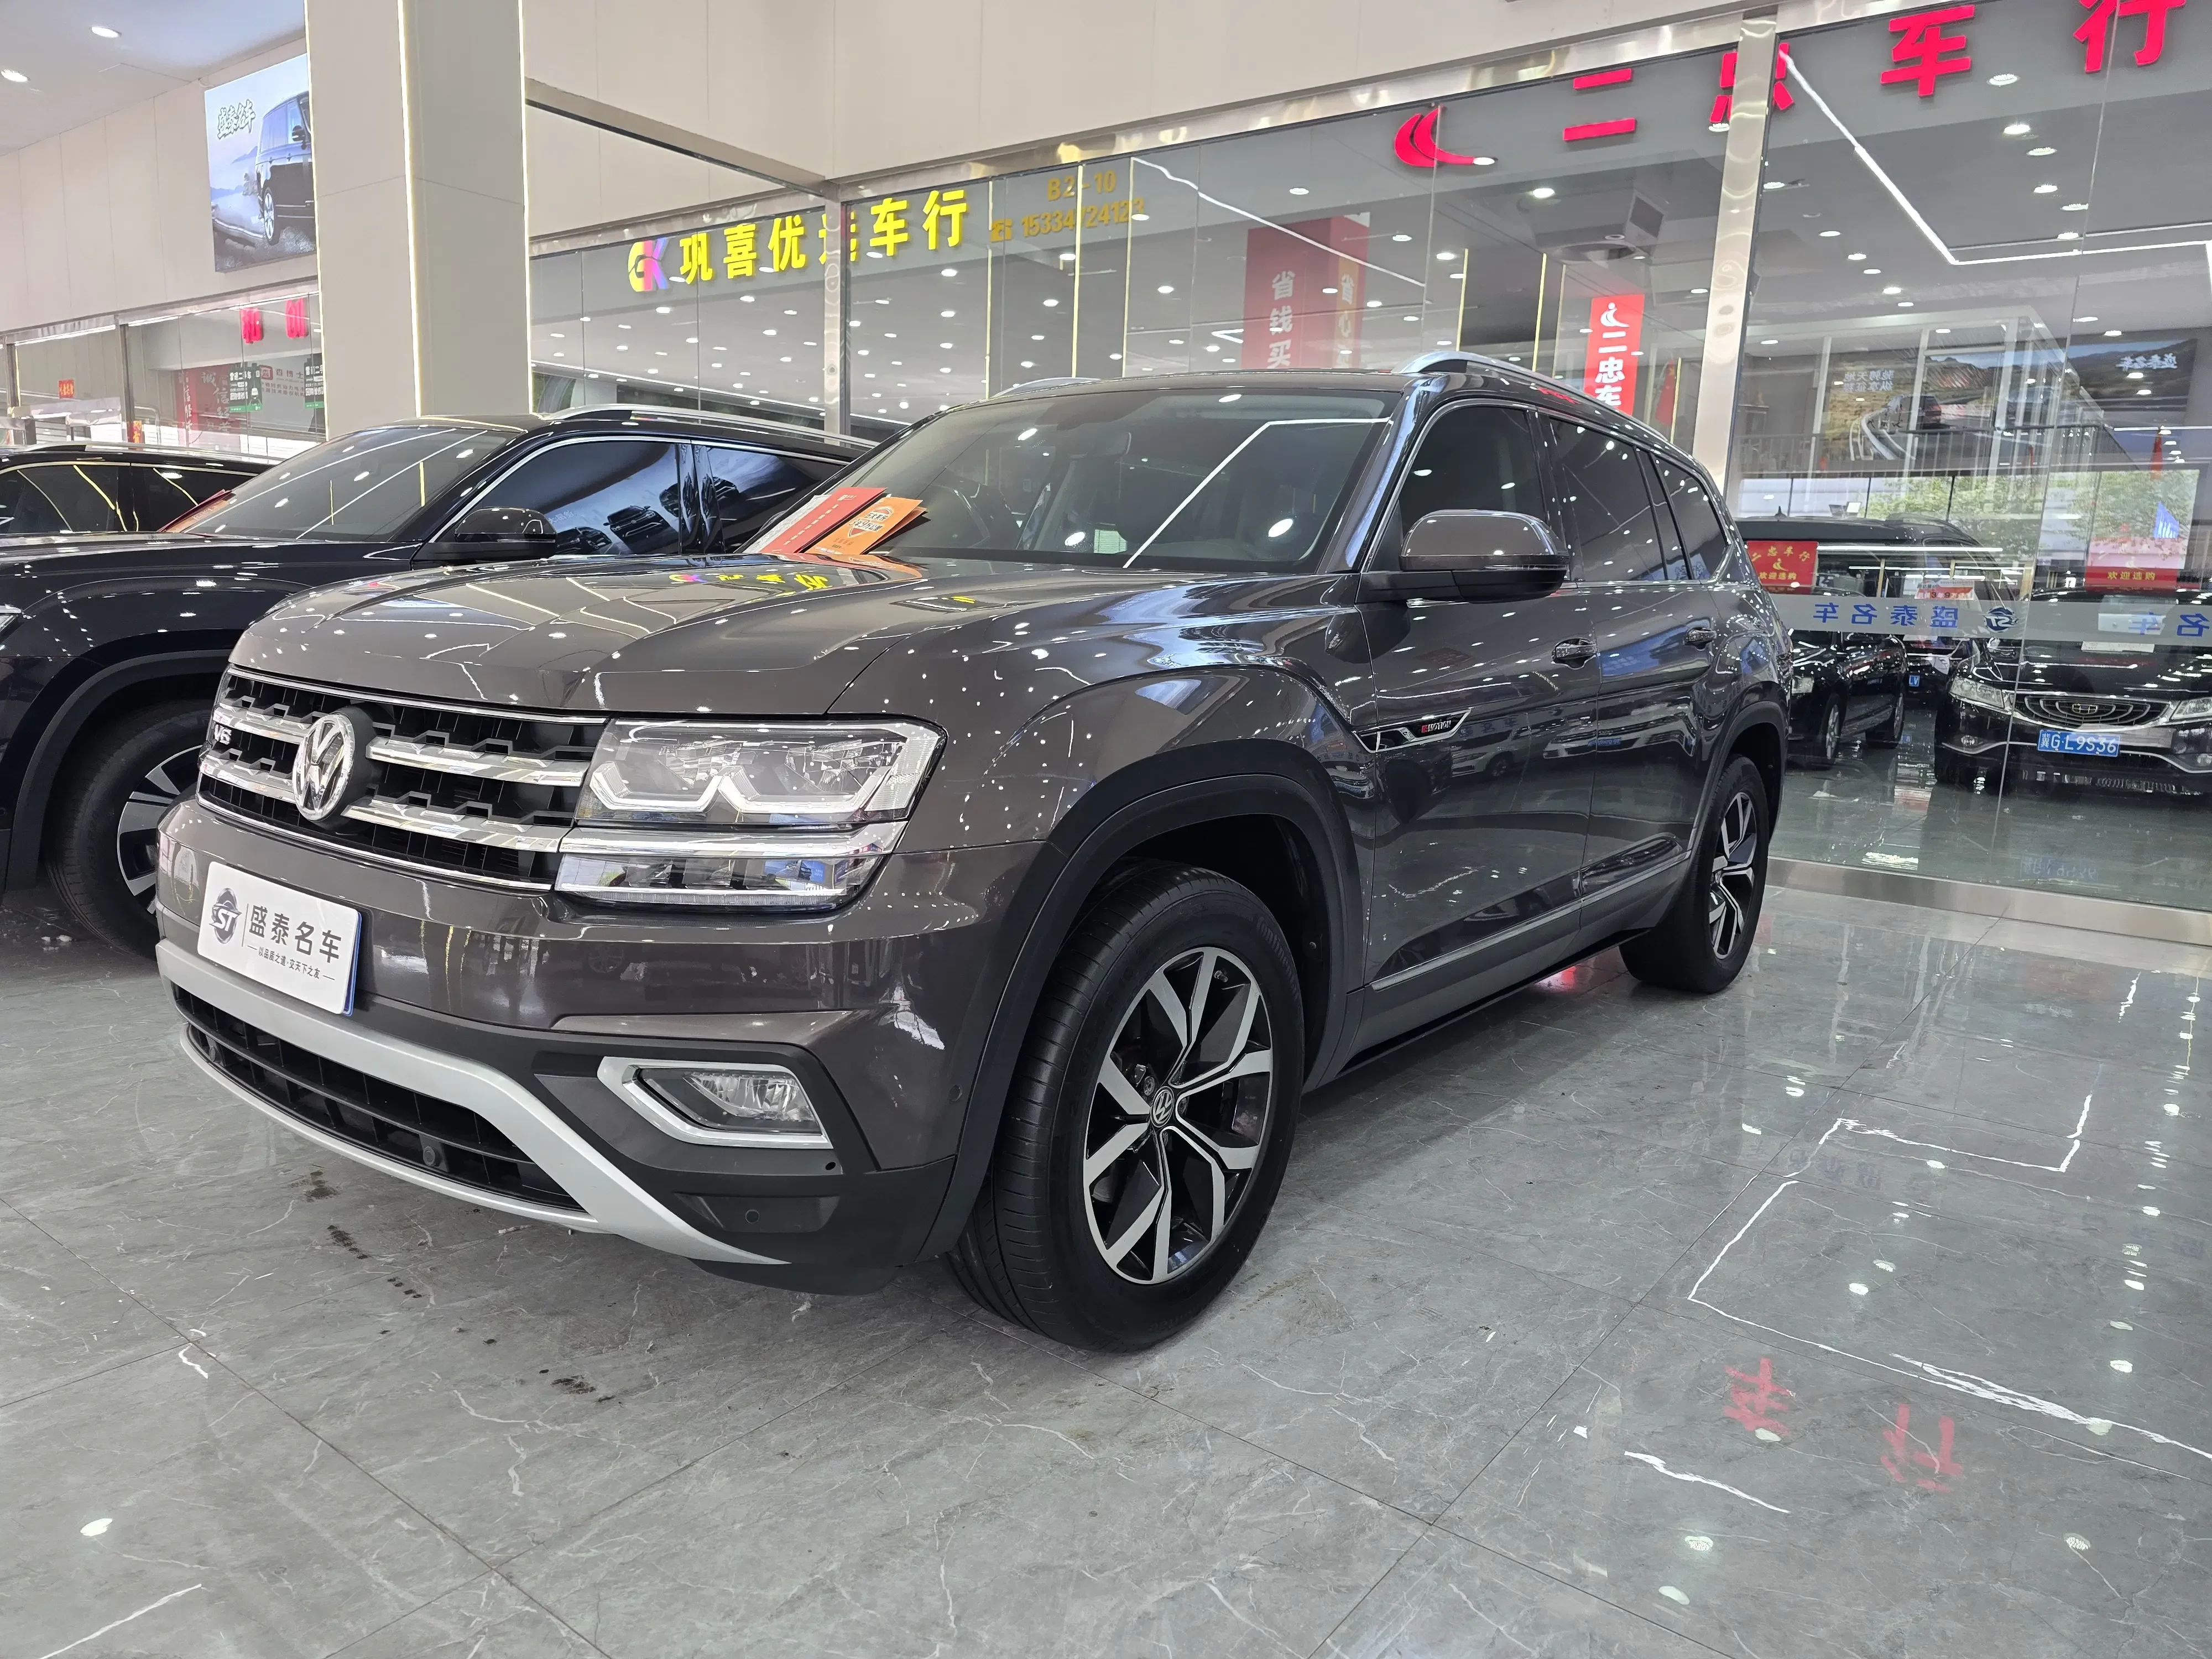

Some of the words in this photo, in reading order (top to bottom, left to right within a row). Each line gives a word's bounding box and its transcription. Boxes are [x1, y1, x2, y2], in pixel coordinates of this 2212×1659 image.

[1595, 331, 1627, 406] 二忠车
[2107, 571, 2156, 581] 欢迎选购
[214, 724, 232, 745] V6
[249, 905, 342, 963] 盛泰名车
